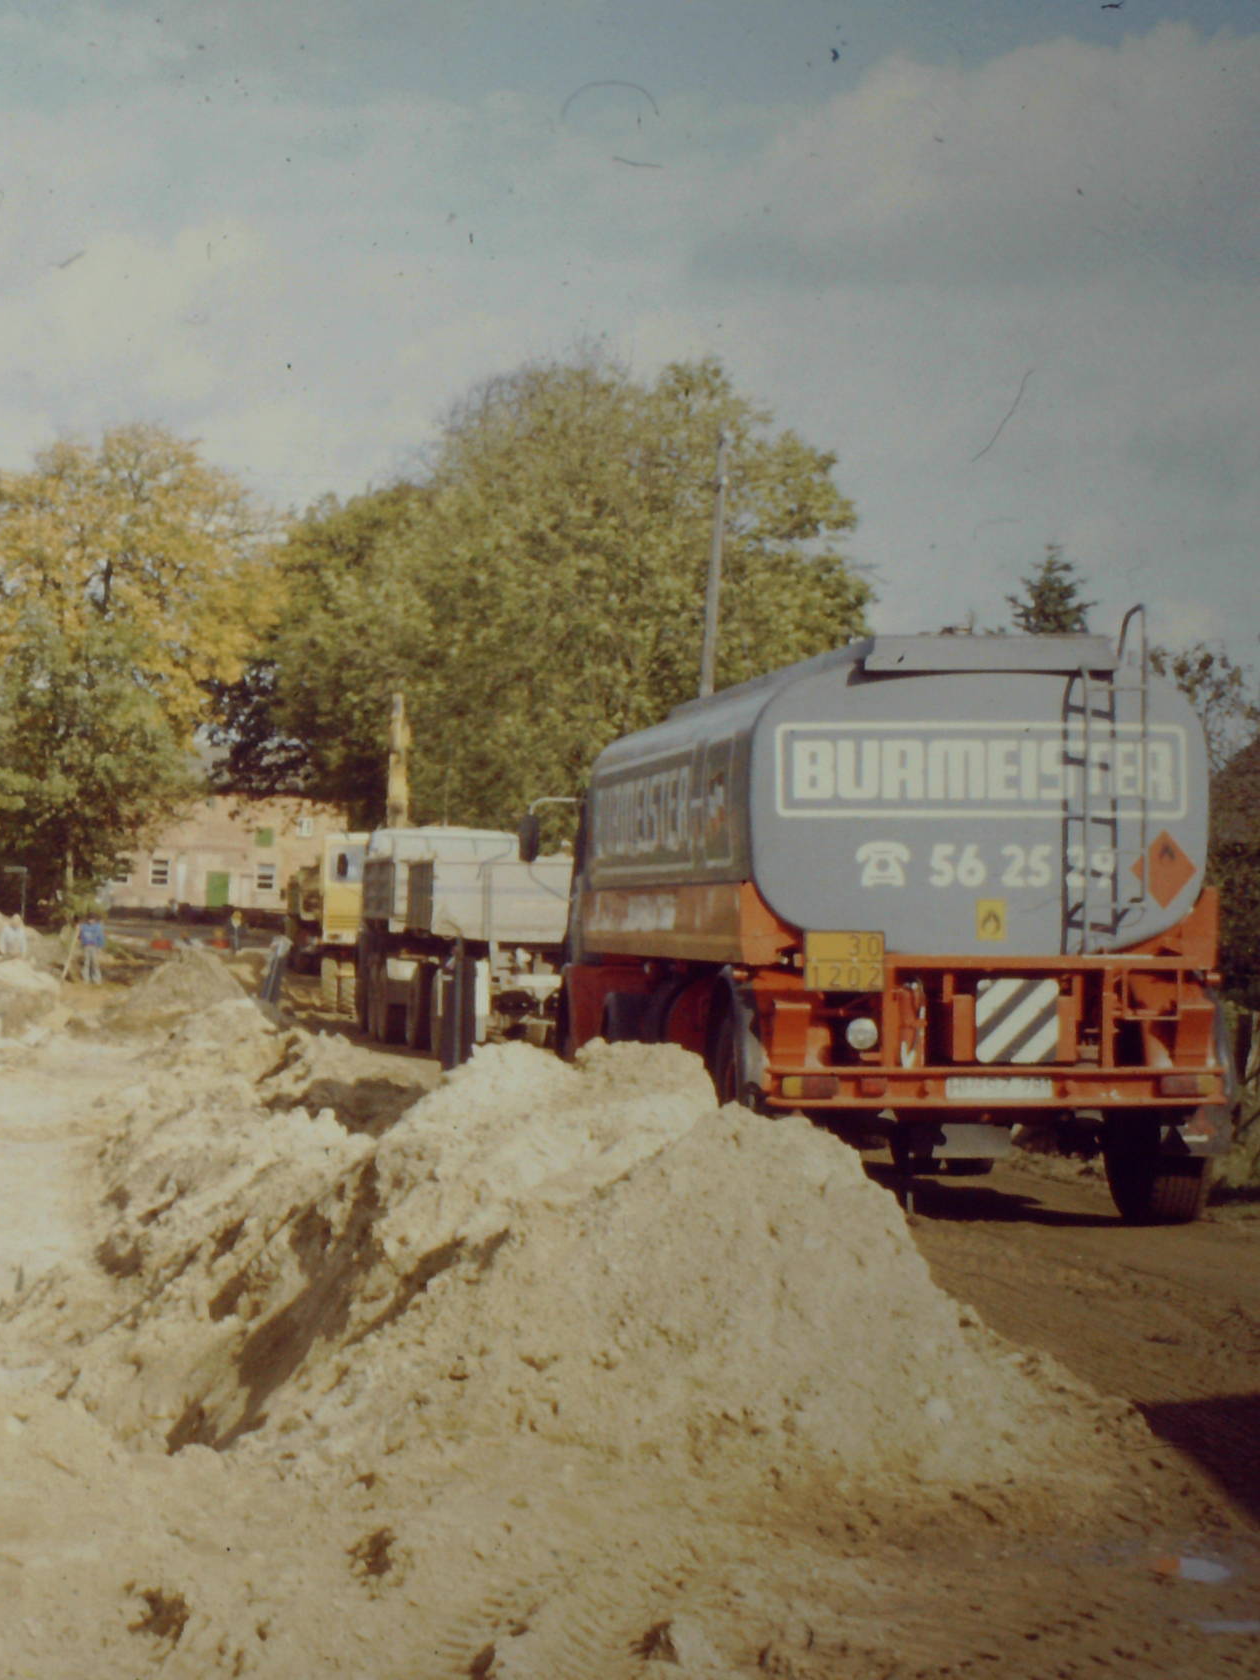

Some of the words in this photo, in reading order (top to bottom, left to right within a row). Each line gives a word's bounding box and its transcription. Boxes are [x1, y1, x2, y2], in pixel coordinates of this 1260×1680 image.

[792, 738, 1174, 802] BURMEISTER
[595, 767, 689, 858] MEISTER
[929, 844, 987, 887] 56
[1001, 844, 1052, 887] 25
[848, 934, 880, 956] 30
[811, 966, 881, 988] 1202
